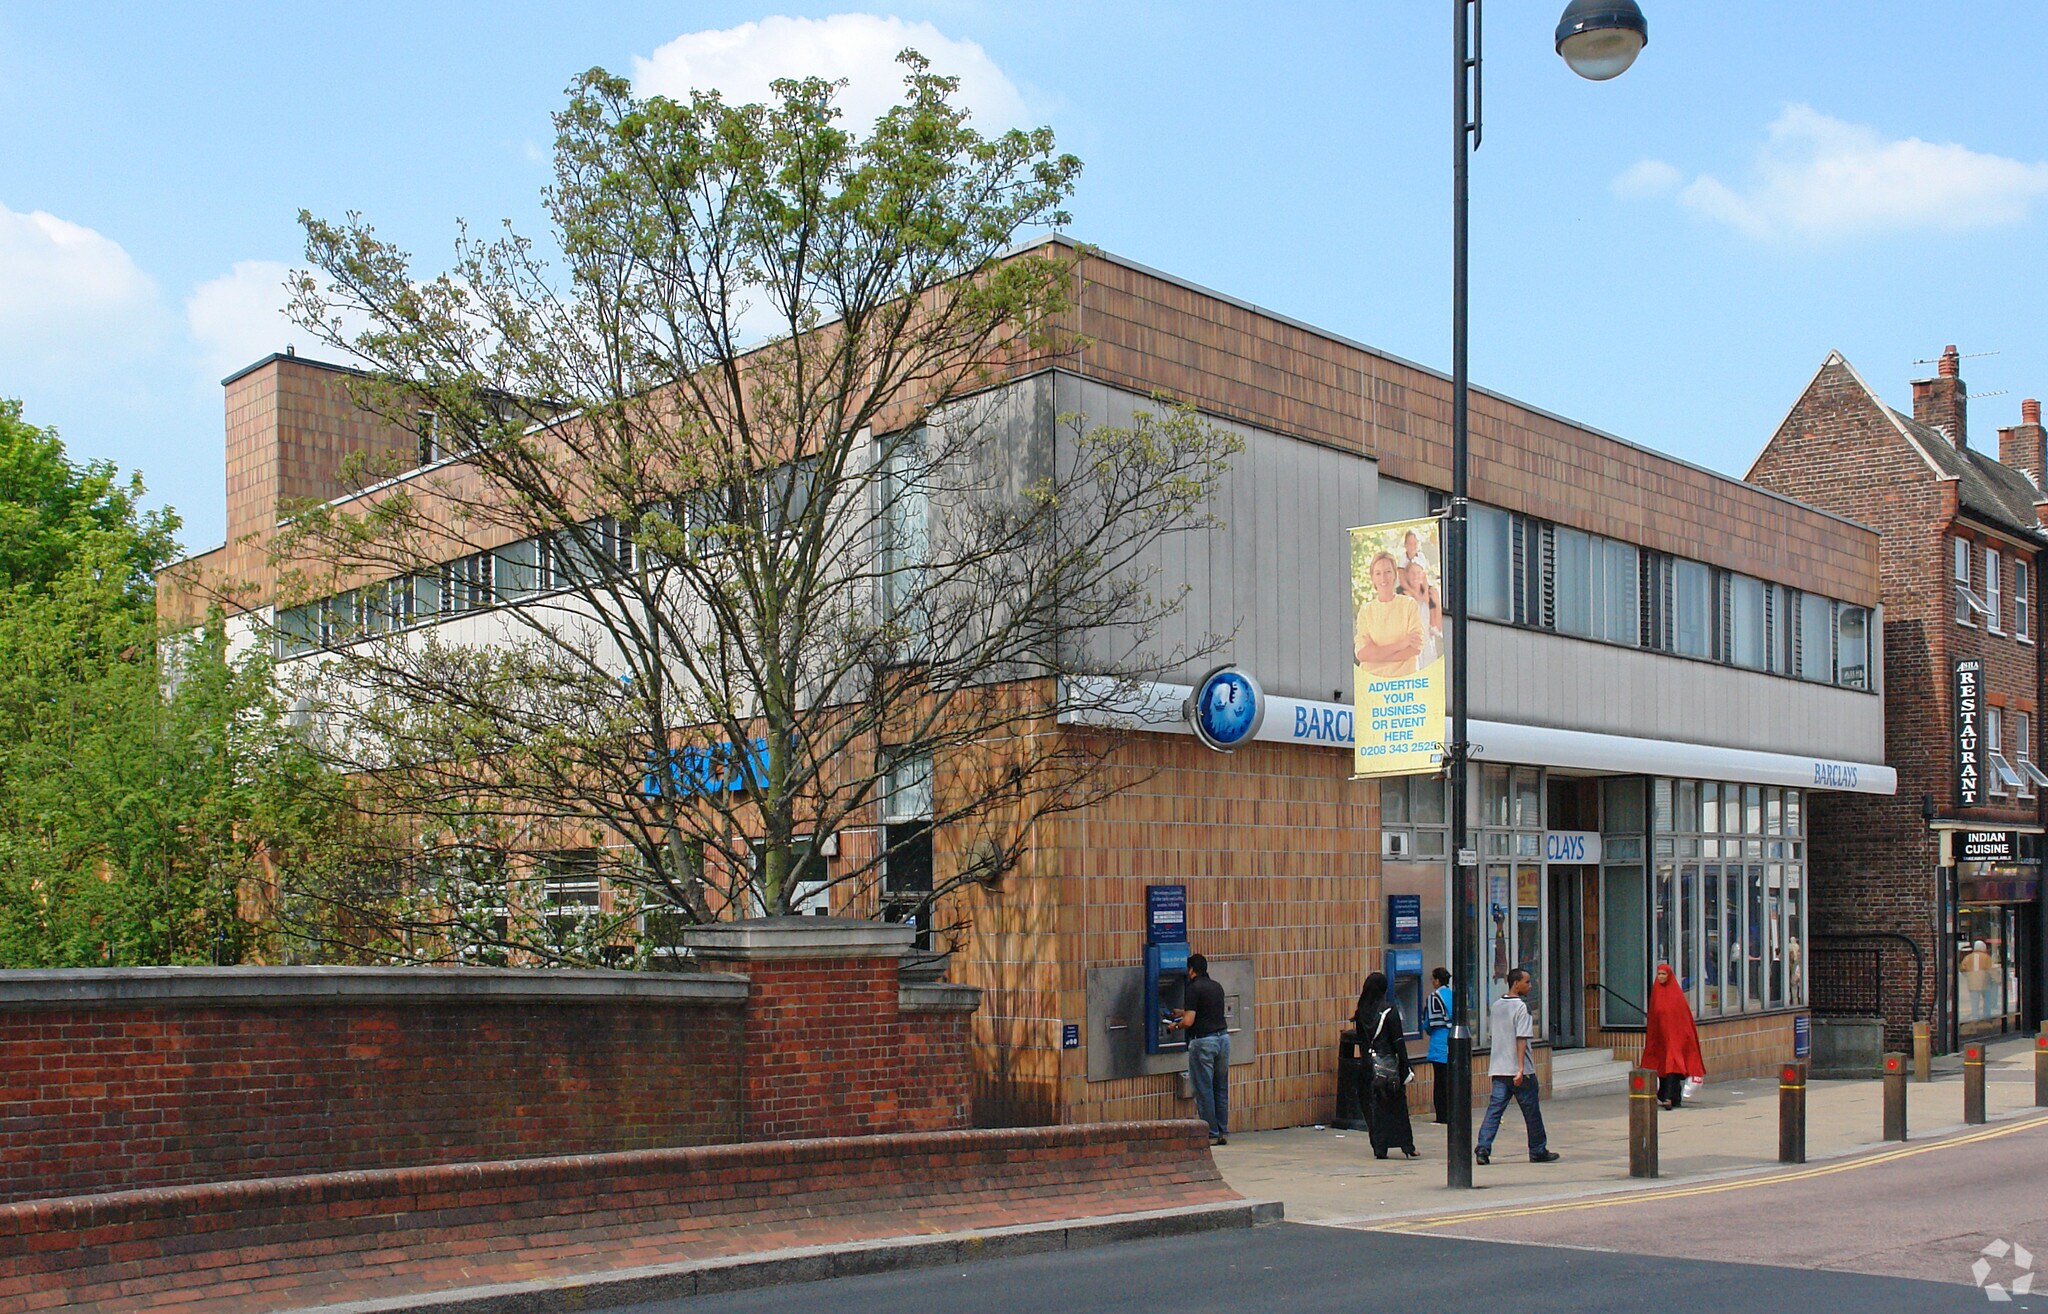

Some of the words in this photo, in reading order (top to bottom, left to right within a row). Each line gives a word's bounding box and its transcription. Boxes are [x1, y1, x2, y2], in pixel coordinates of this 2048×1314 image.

[1368, 678, 1429, 693] ADVERTISE
[1383, 692, 1414, 704] YOUR
[1372, 703, 1426, 718] BUSINESS
[1372, 720, 1388, 730] OR
[1391, 716, 1426, 729] EVENT
[1384, 730, 1414, 742] HERE
[1960, 672, 1977, 803] RESTAURANT
[1360, 744, 1386, 756] 0208
[1389, 743, 1408, 754] 343
[1813, 763, 1858, 788] BARCLAYS
[1968, 832, 2006, 843] INDIAN
[1547, 835, 1585, 860] CLAYS
[1965, 843, 2010, 854] CUISINE
